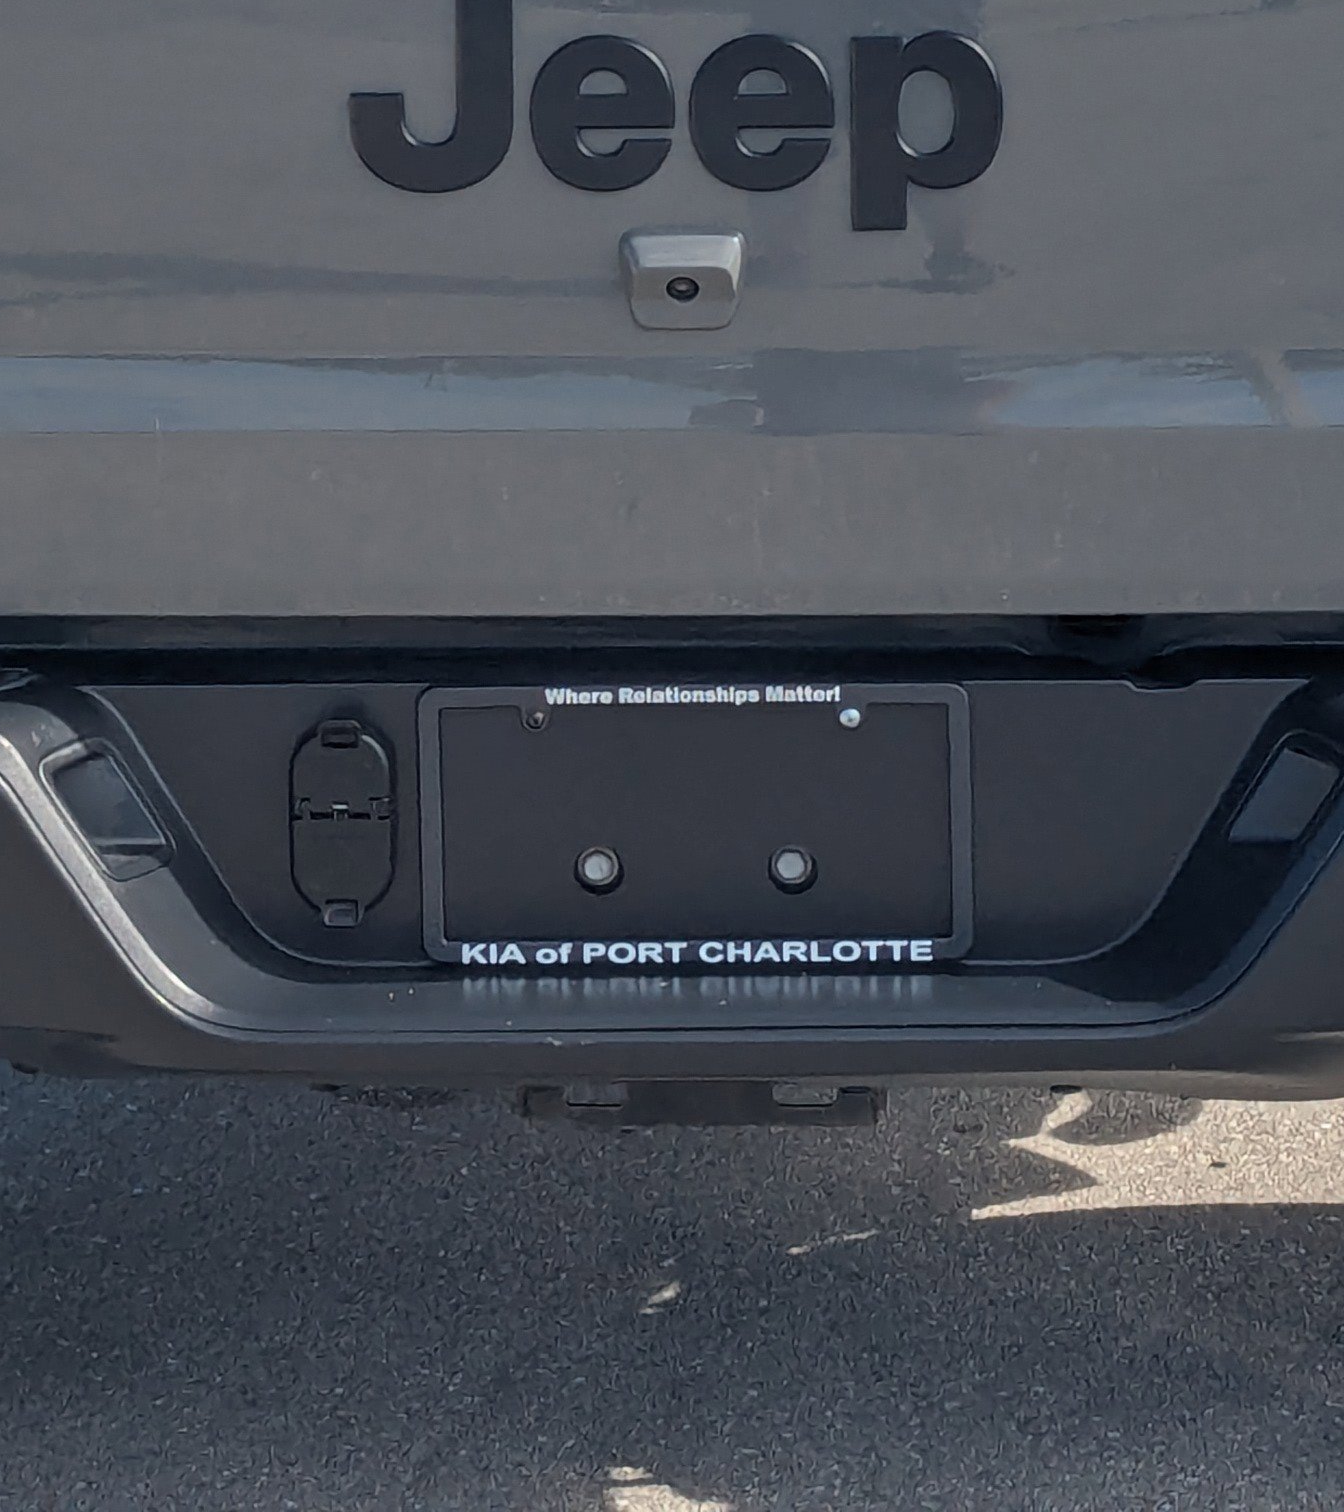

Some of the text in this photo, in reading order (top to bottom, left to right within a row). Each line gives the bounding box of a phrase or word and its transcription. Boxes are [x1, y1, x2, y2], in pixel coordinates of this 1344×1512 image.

[544, 685, 841, 706] Where Relationships Matter!
[461, 940, 934, 965] KIA of PORT CHARLOTTE
